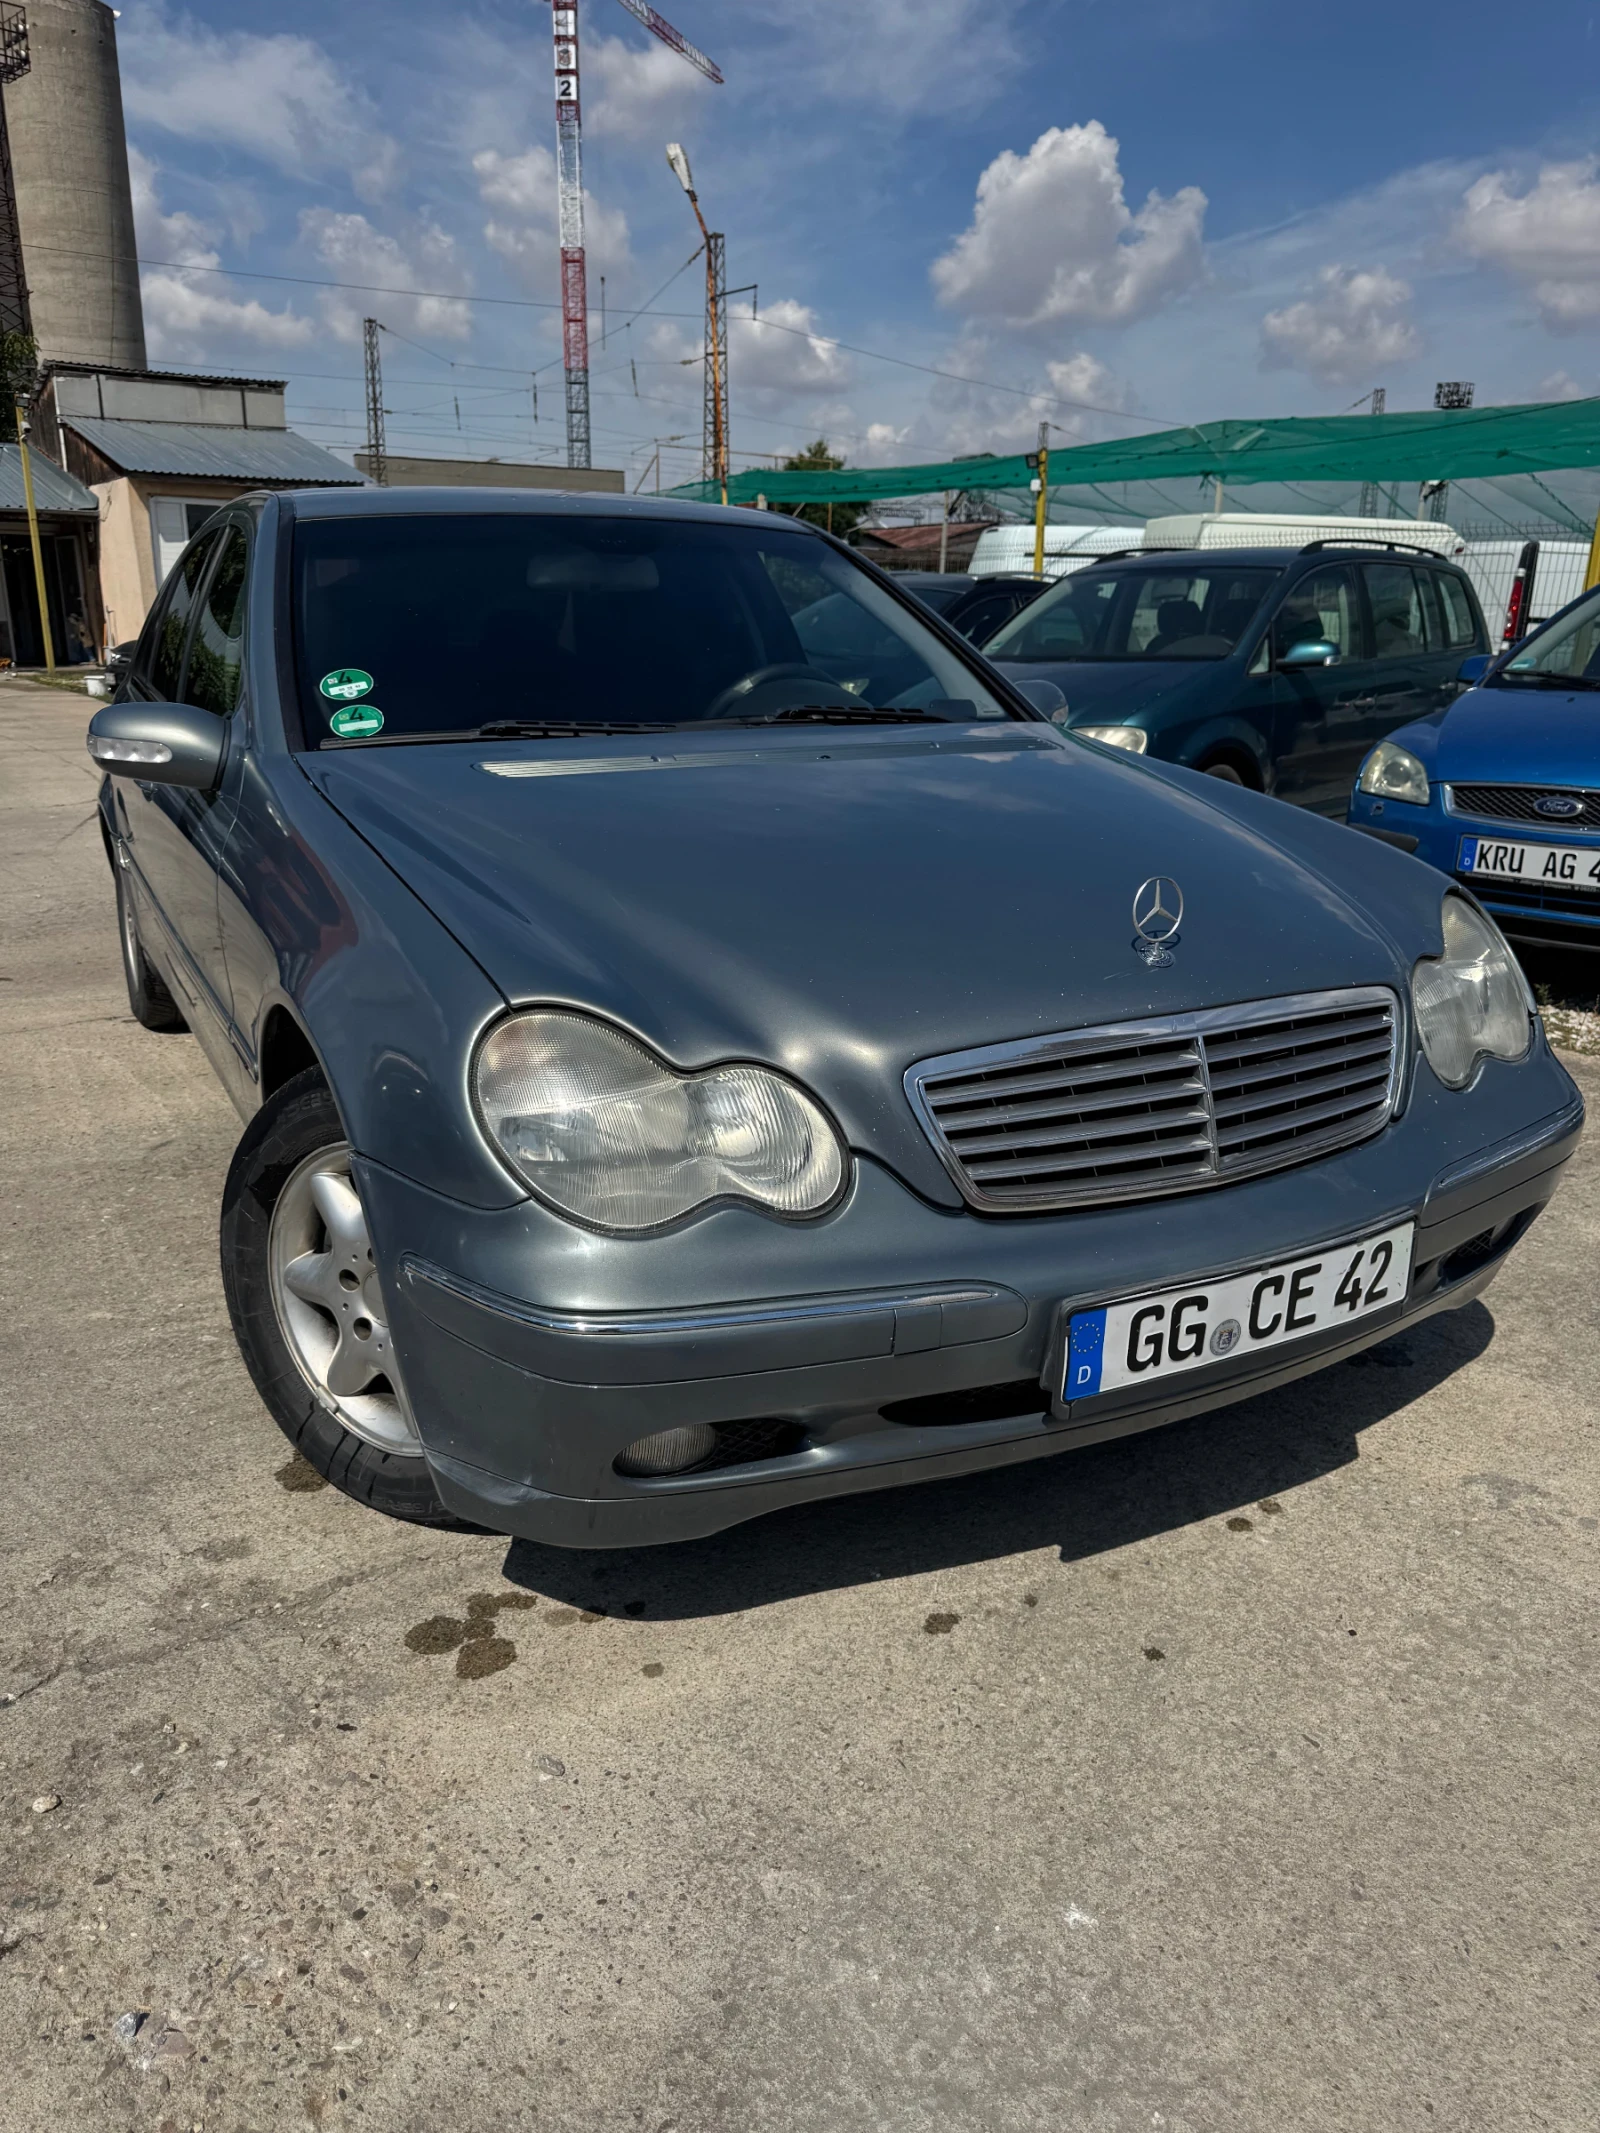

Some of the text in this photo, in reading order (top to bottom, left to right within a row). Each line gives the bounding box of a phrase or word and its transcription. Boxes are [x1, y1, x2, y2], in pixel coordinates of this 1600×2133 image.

[560, 80, 571, 96] 2
[338, 671, 353, 684] 4
[350, 707, 364, 721] 4
[1543, 801, 1571, 812] Ford
[1464, 857, 1471, 866] D
[1477, 844, 1525, 873] KRU
[1542, 851, 1578, 879] AG
[1126, 1295, 1209, 1372] GG
[1248, 1263, 1323, 1339] CE
[1334, 1240, 1393, 1312] 42
[1076, 1365, 1091, 1384] D
